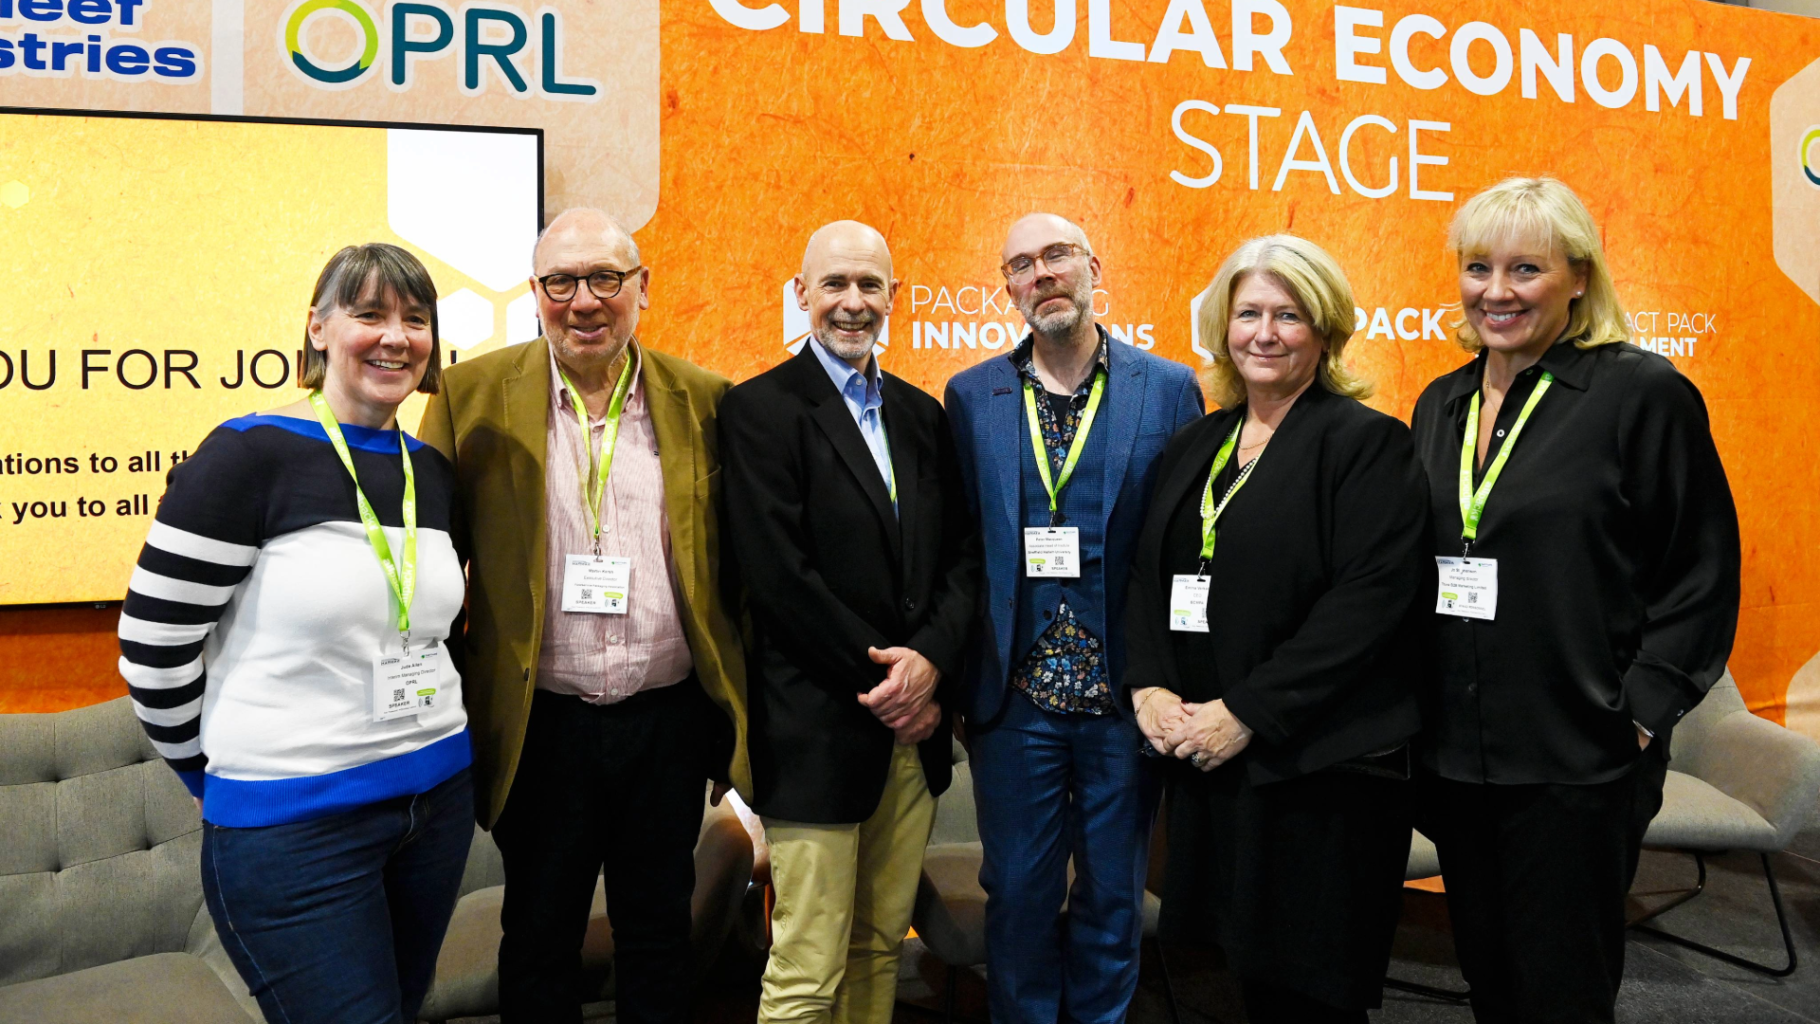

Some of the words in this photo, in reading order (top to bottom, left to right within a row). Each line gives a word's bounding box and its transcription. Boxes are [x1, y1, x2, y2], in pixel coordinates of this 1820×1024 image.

[0, 0, 143, 25] eef
[285, 0, 597, 95] OPRL
[1334, 4, 1752, 120] ECONOMY
[1169, 99, 1454, 202] STAGE
[1668, 312, 1717, 334] PACK
[1631, 336, 1697, 357] MENT
[81, 349, 202, 390] FOR
[0, 453, 79, 474] tions
[89, 453, 118, 473] to
[128, 450, 161, 472] all
[12, 501, 67, 525] you
[77, 496, 106, 517] to
[116, 494, 148, 515] all
